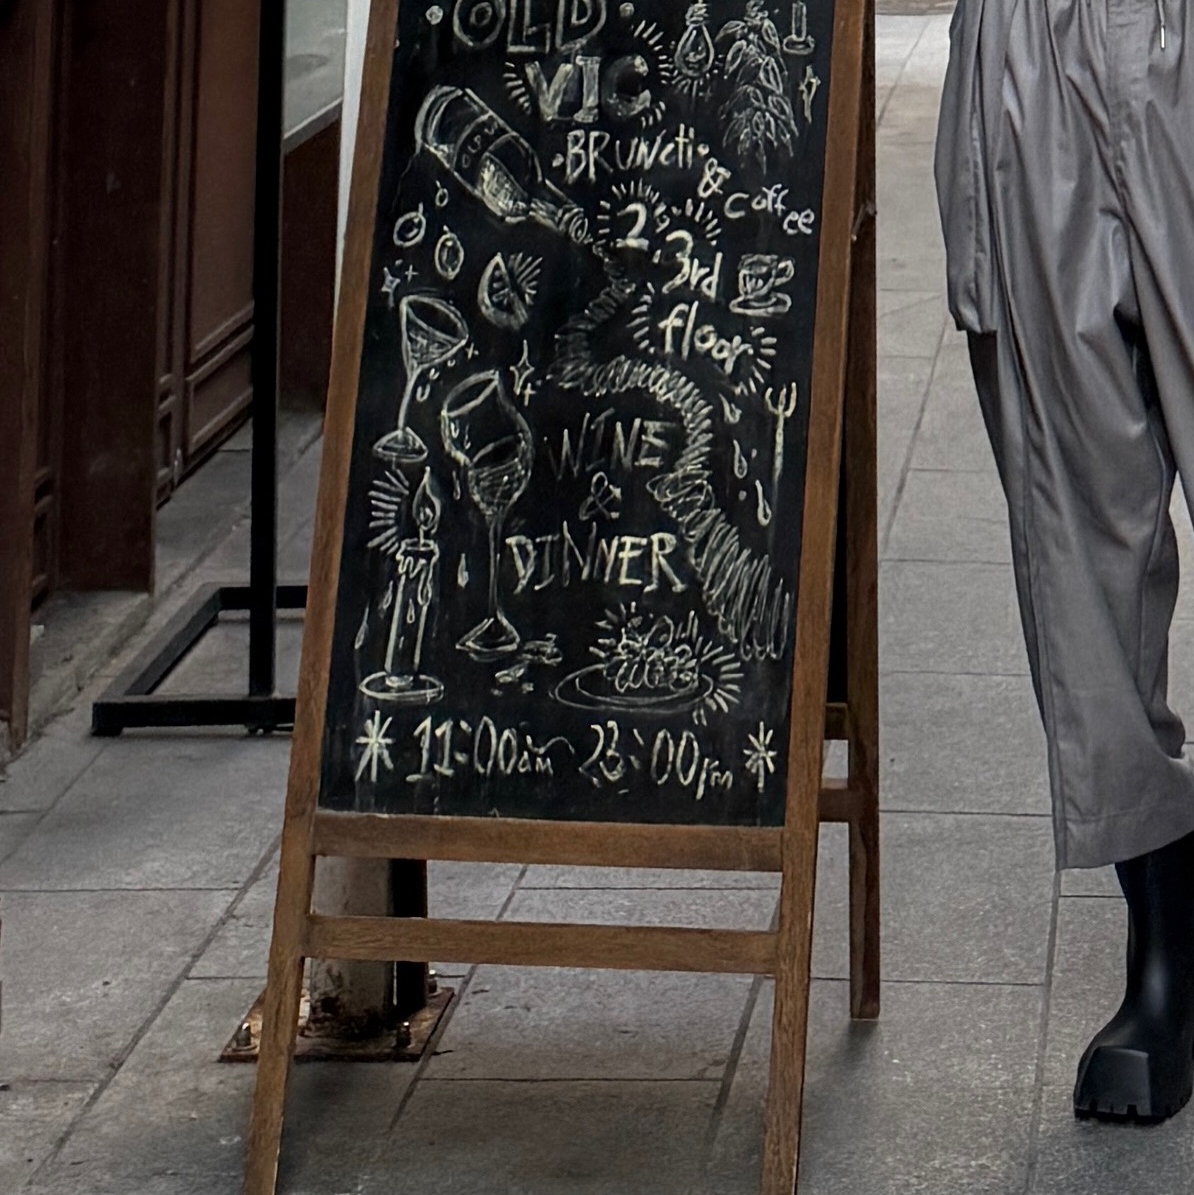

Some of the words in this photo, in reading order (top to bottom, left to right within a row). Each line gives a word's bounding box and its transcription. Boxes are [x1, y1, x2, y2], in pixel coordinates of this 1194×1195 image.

[524, 55, 652, 123] VIC
[698, 157, 731, 198] &
[658, 300, 754, 375] floor
[548, 407, 677, 480] WINE
[578, 471, 623, 521] &
[505, 520, 688, 595] DINNER
